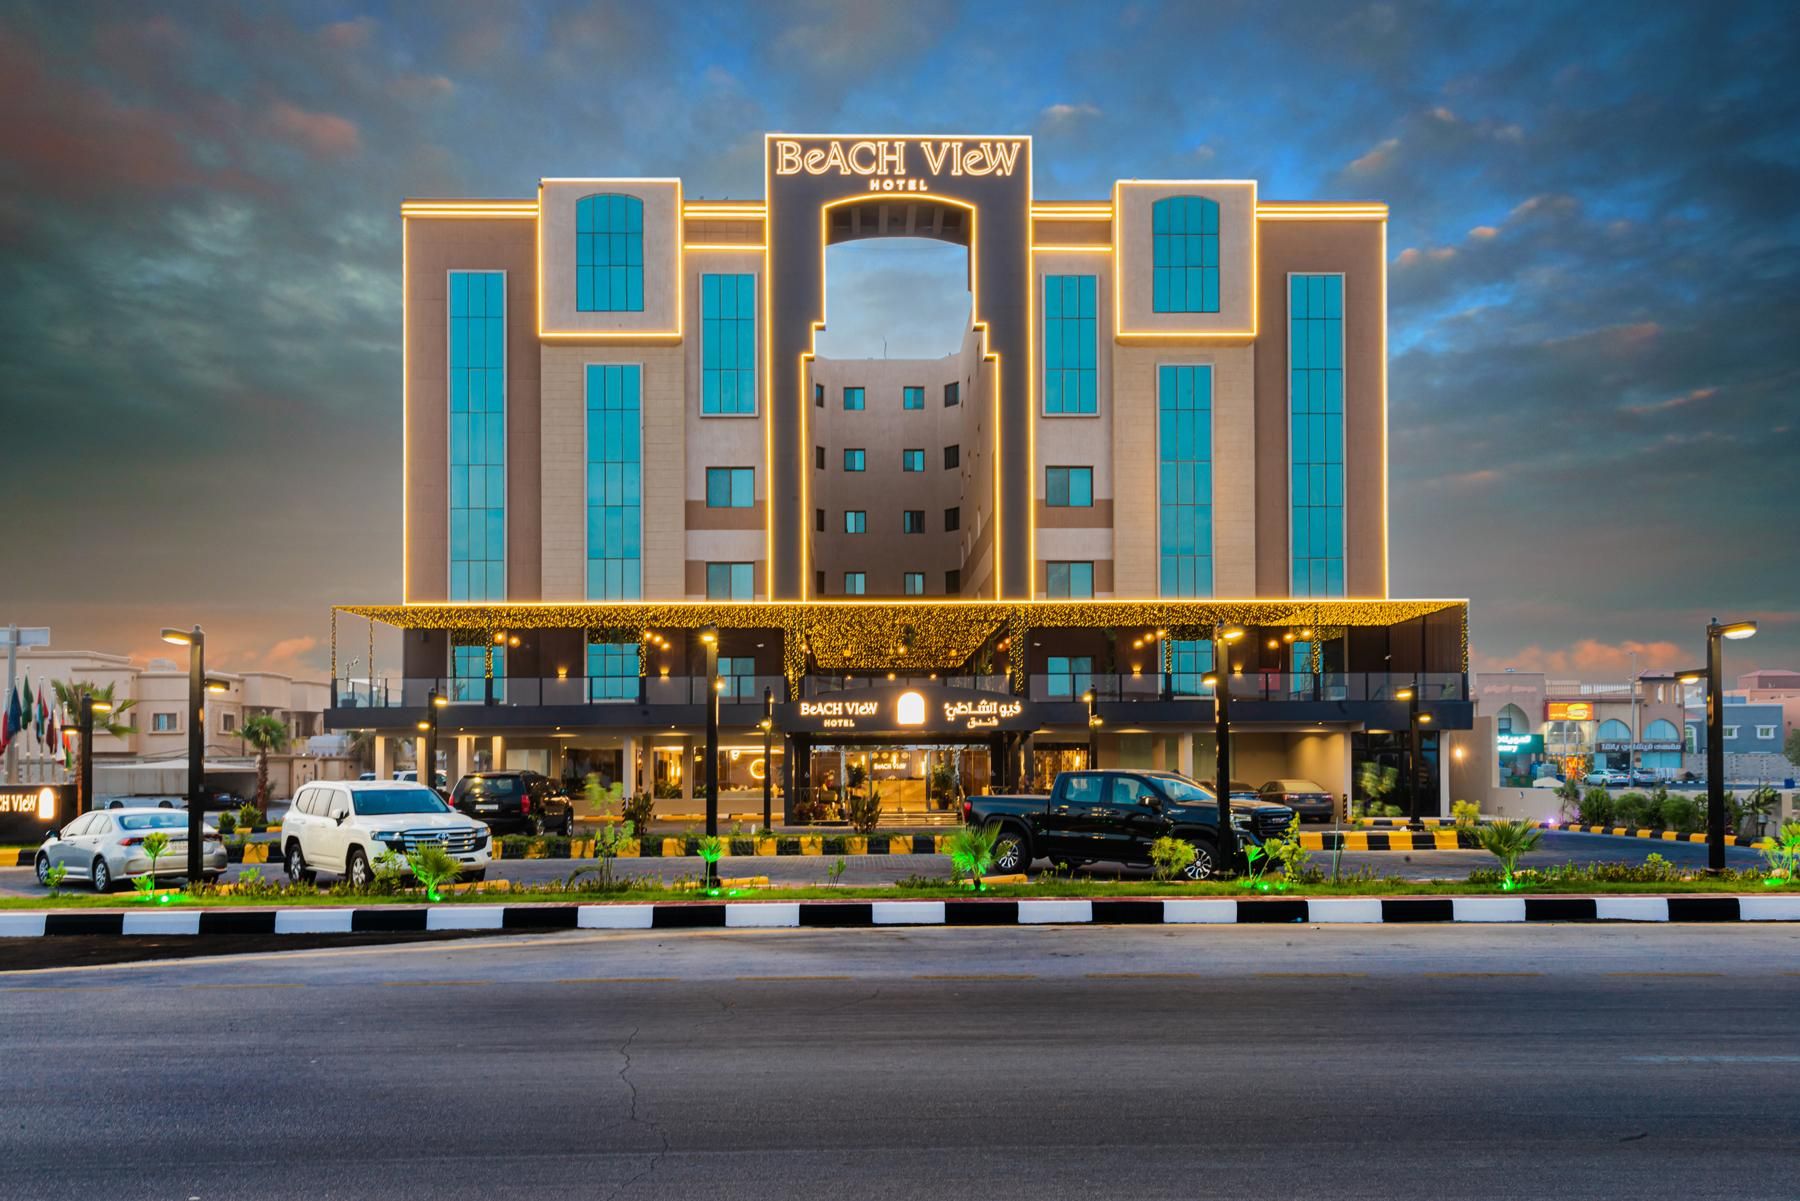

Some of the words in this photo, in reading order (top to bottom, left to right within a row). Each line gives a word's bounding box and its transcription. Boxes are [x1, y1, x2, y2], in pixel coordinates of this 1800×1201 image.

[776, 141, 906, 176] BeACH
[920, 142, 1021, 176] VIeW
[869, 179, 928, 191] HOTEL
[800, 702, 843, 715] BeACH
[845, 702, 879, 715] VIeW
[999, 700, 1022, 717] فيو
[823, 719, 855, 727] HOTEL
[967, 716, 999, 729] فندق
